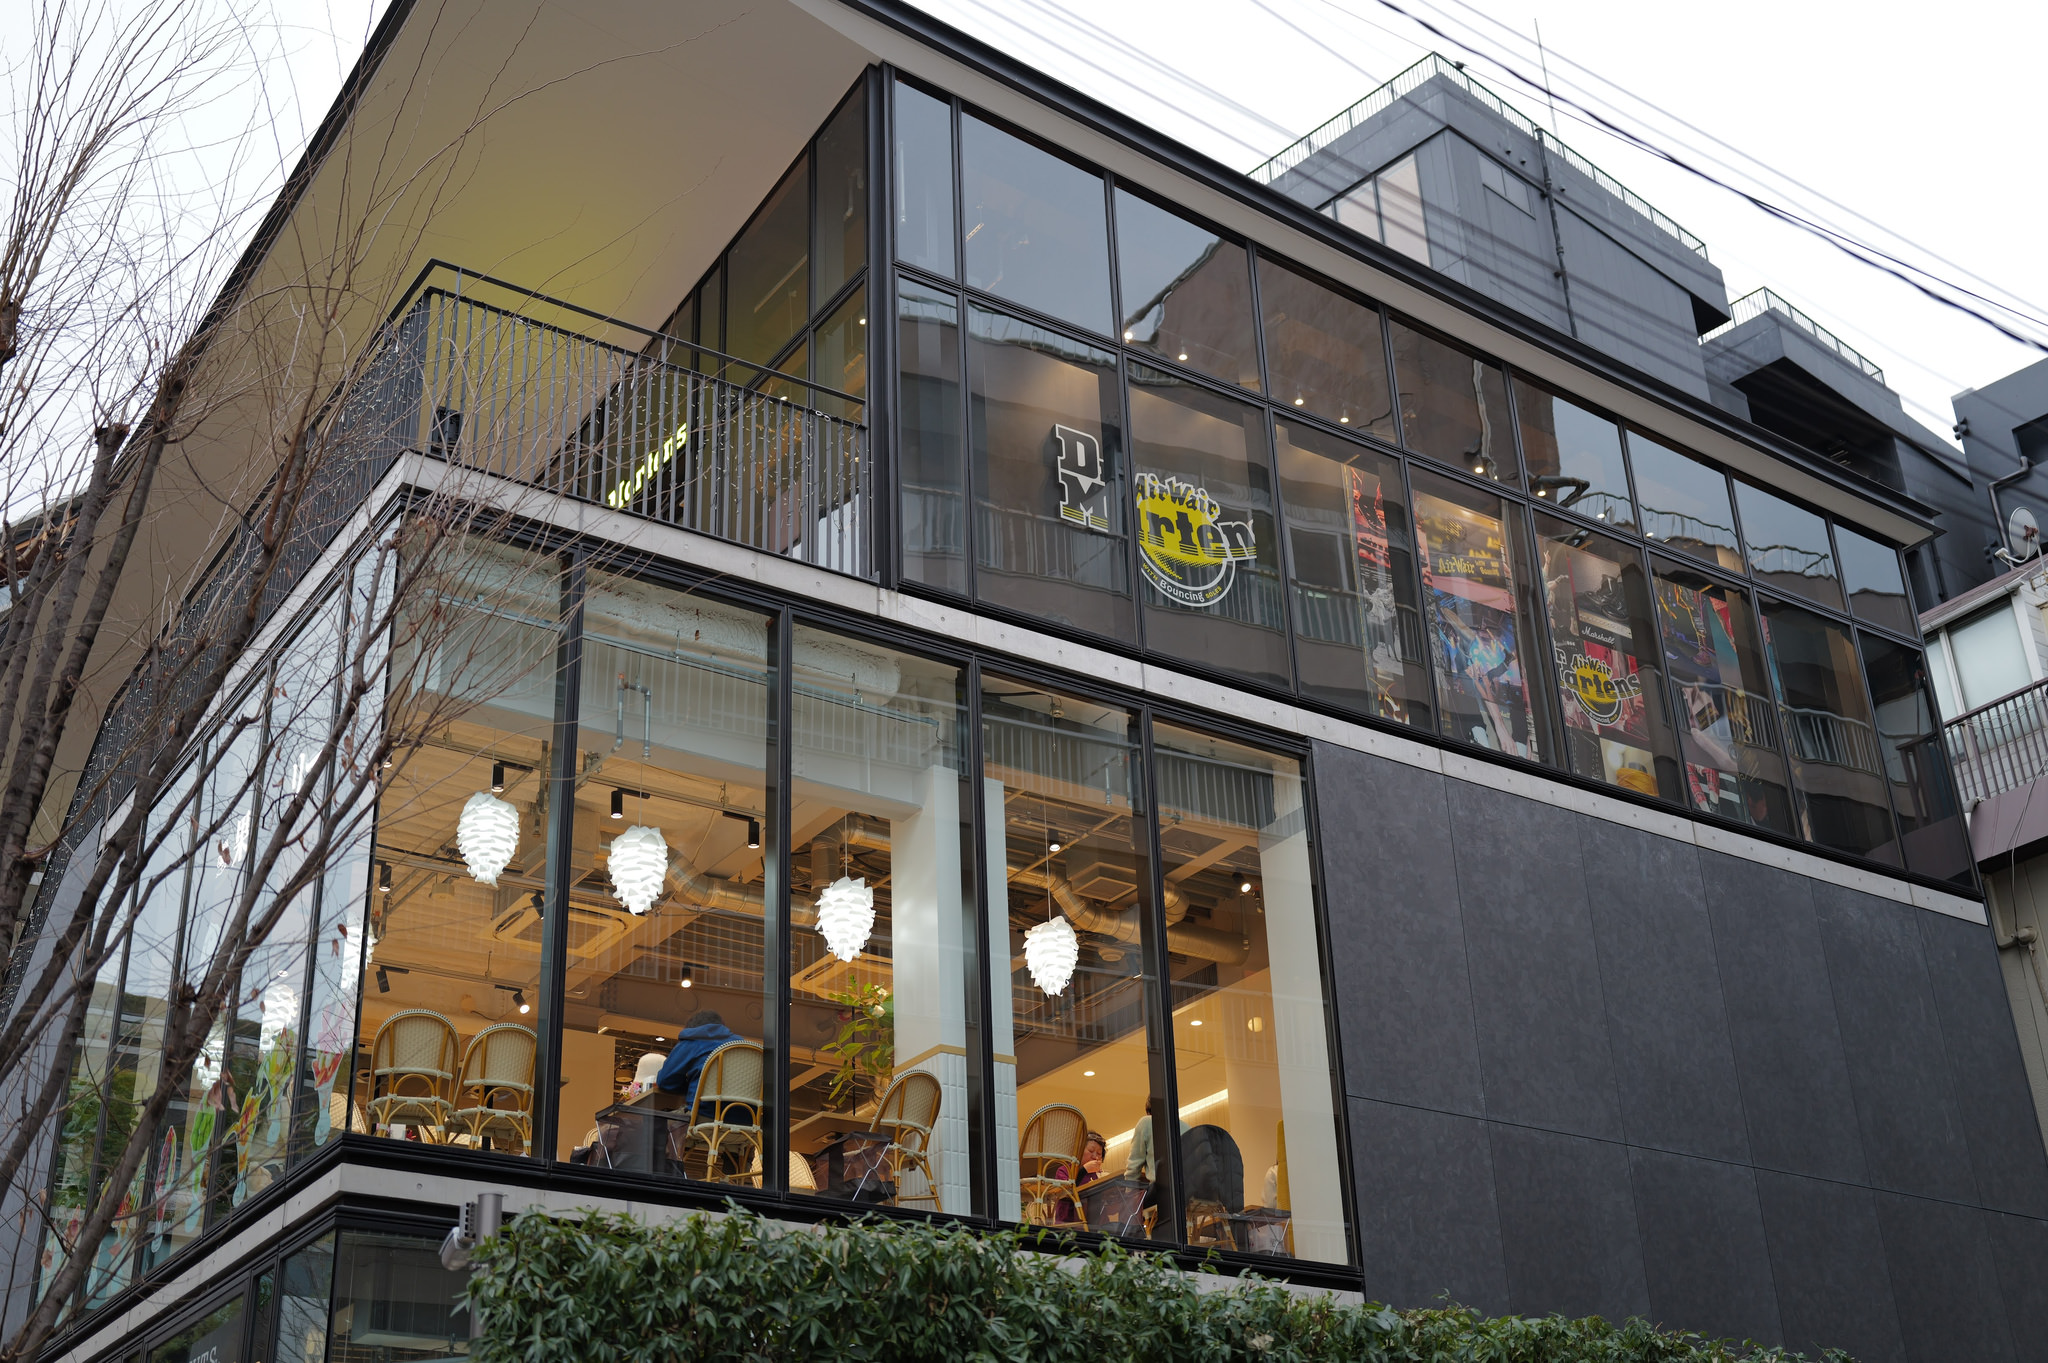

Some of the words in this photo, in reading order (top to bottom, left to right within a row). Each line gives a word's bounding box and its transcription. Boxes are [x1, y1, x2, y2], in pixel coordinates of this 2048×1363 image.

[1160, 579, 1206, 602] Bouncing
[1582, 626, 1615, 645] Marshall
[1571, 654, 1613, 678] AirWair
[1560, 670, 1642, 700] artens
